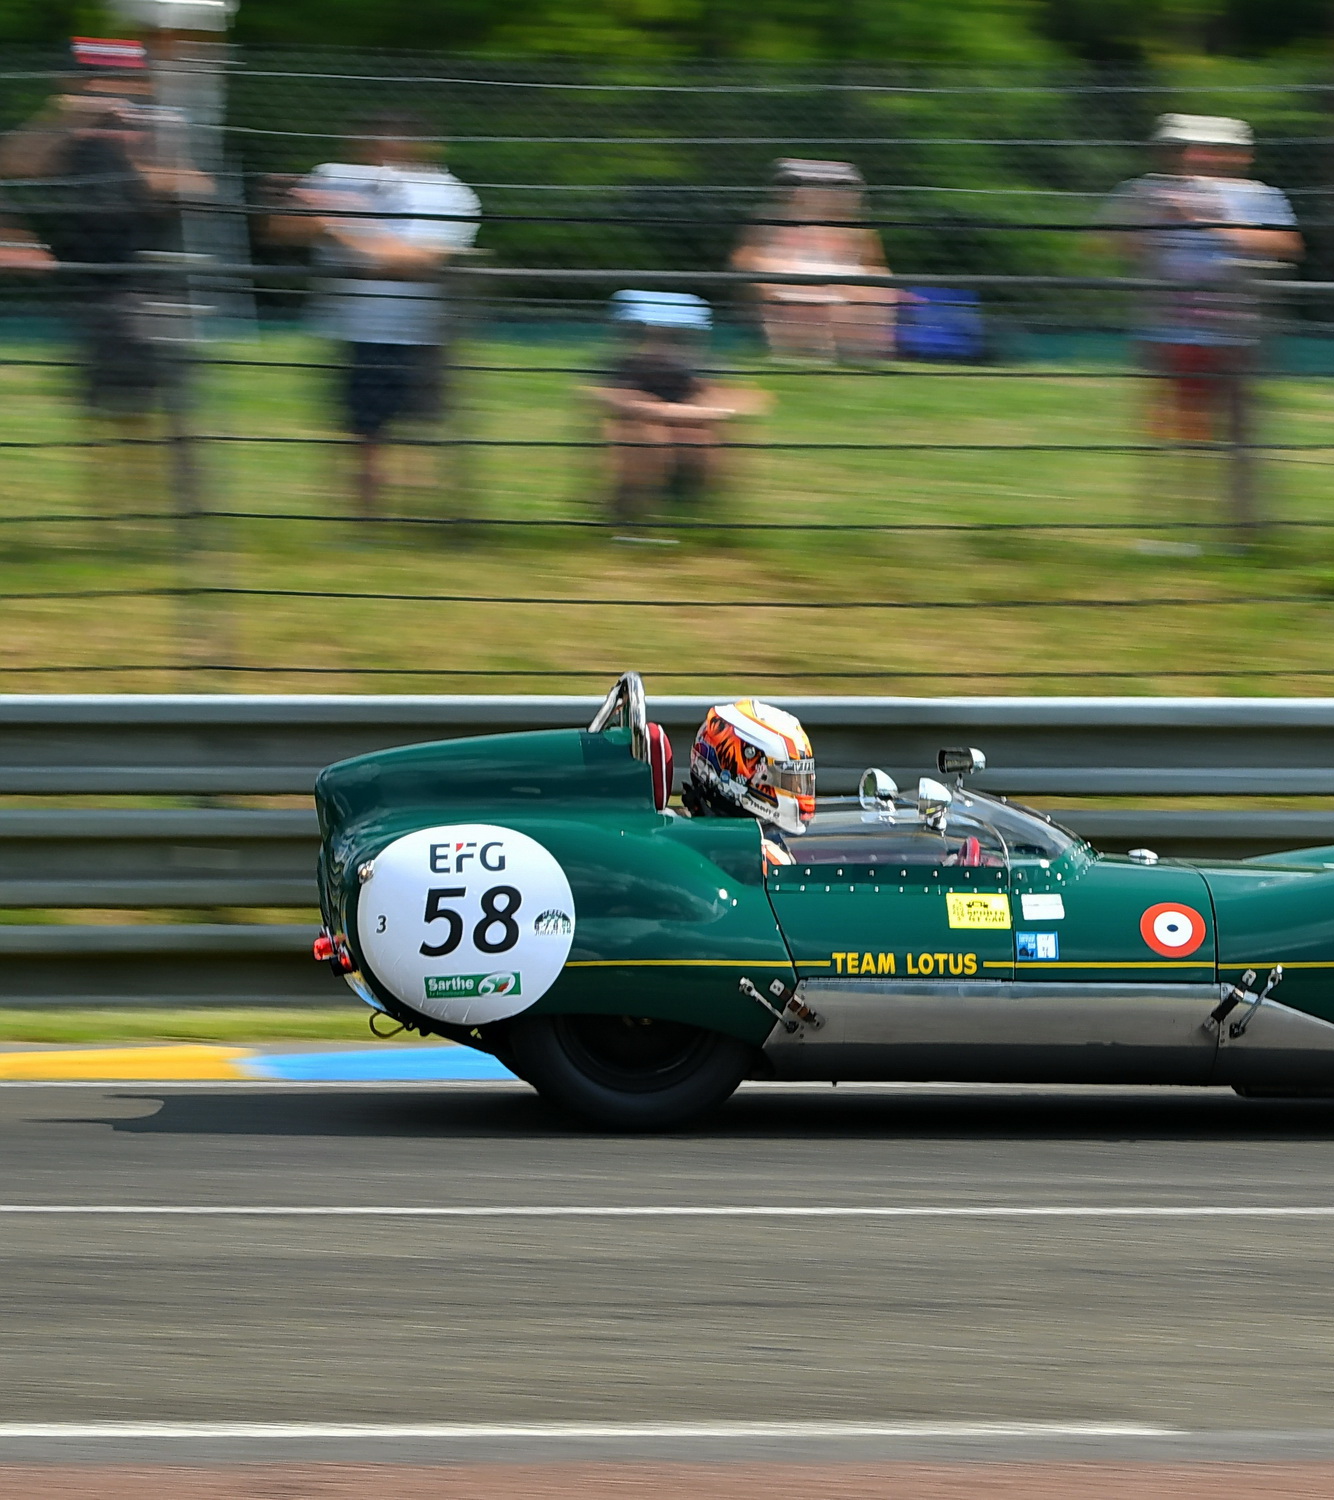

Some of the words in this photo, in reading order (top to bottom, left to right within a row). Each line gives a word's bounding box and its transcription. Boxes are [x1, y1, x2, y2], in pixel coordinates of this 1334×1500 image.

[430, 842, 506, 873] EFG
[376, 915, 387, 934] 3
[419, 885, 522, 957] 58
[832, 952, 896, 975] TEAM
[907, 953, 977, 975] LOTUS
[428, 976, 474, 992] Sarthe
